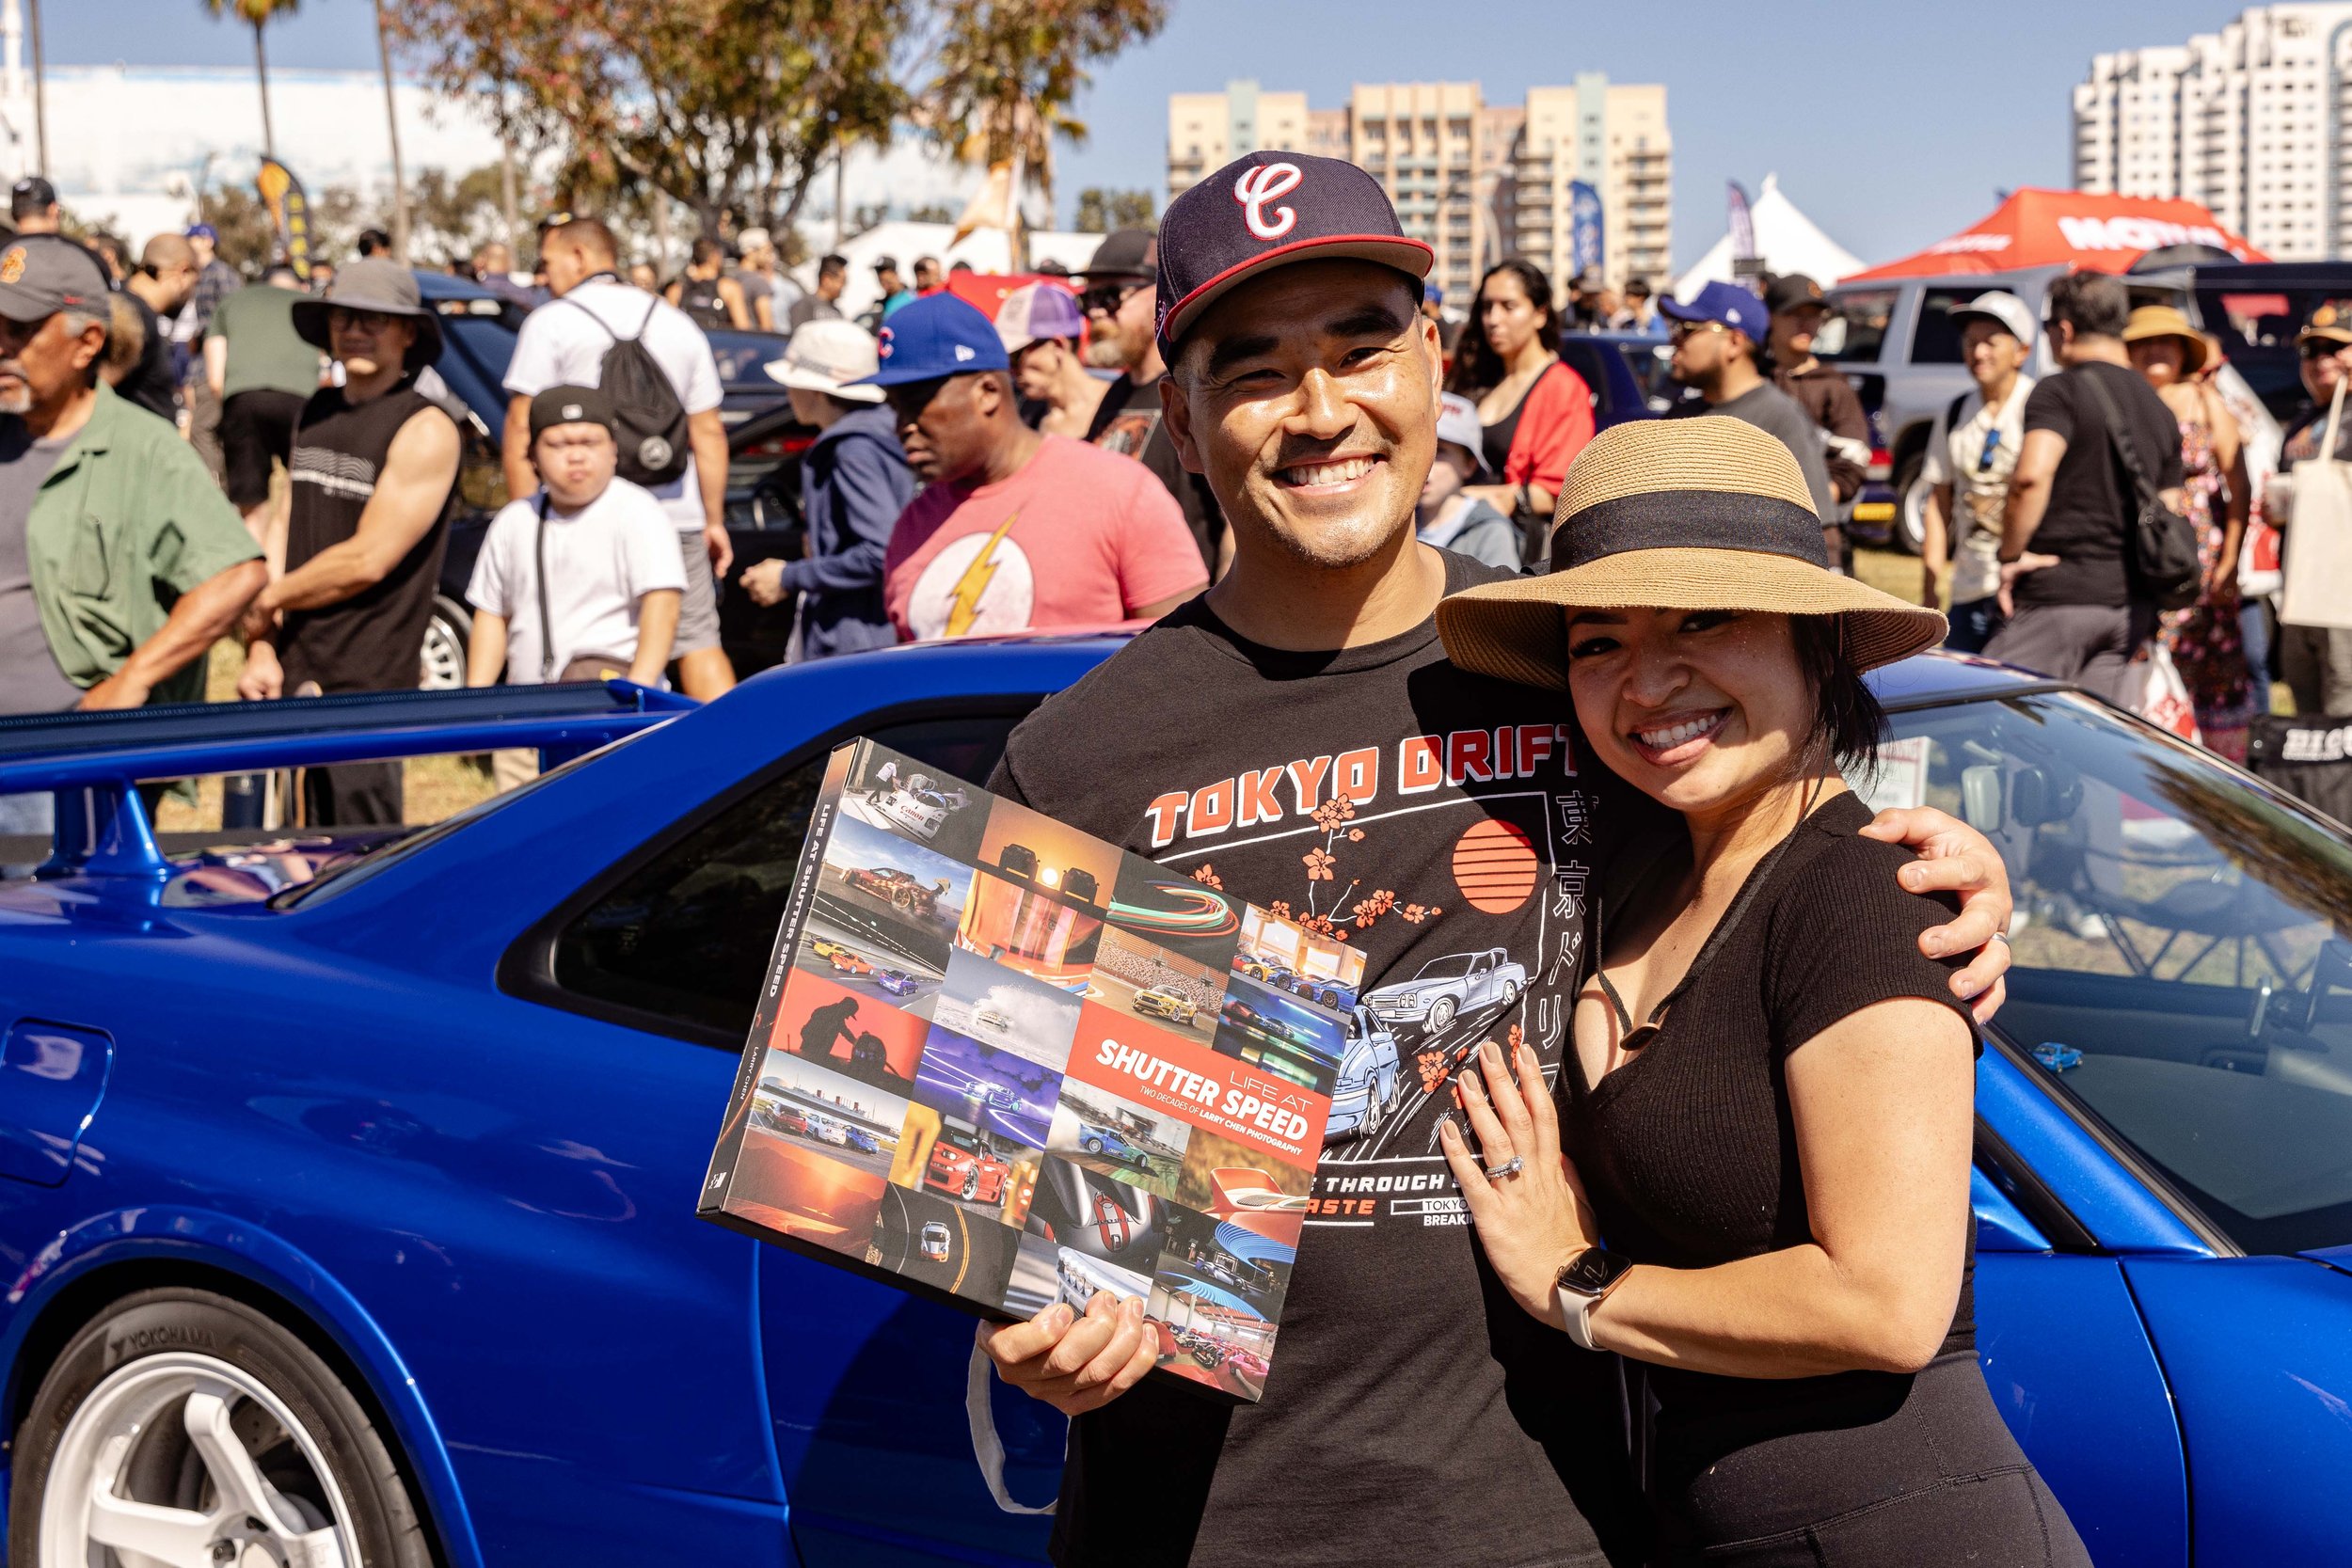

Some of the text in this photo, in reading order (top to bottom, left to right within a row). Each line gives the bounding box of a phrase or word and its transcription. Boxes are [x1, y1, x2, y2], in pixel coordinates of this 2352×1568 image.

[1232, 162, 1304, 241] C
[900, 805, 925, 821] Canon
[1145, 723, 1580, 847] TOKYO DRIFT
[770, 803, 831, 998] LIFE AT SHUTTER SPEED
[739, 1046, 759, 1101] LARRY CHEN
[1095, 1038, 1309, 1141] SHUTTER SPEED
[1229, 1069, 1313, 1113] LIFE AT
[1139, 1085, 1303, 1156] TWO DECADES OF LARRY CHEN PHOTOGRAPHY
[1326, 1174, 1445, 1193] THROUGH
[1425, 1199, 1468, 1211] TOKYO
